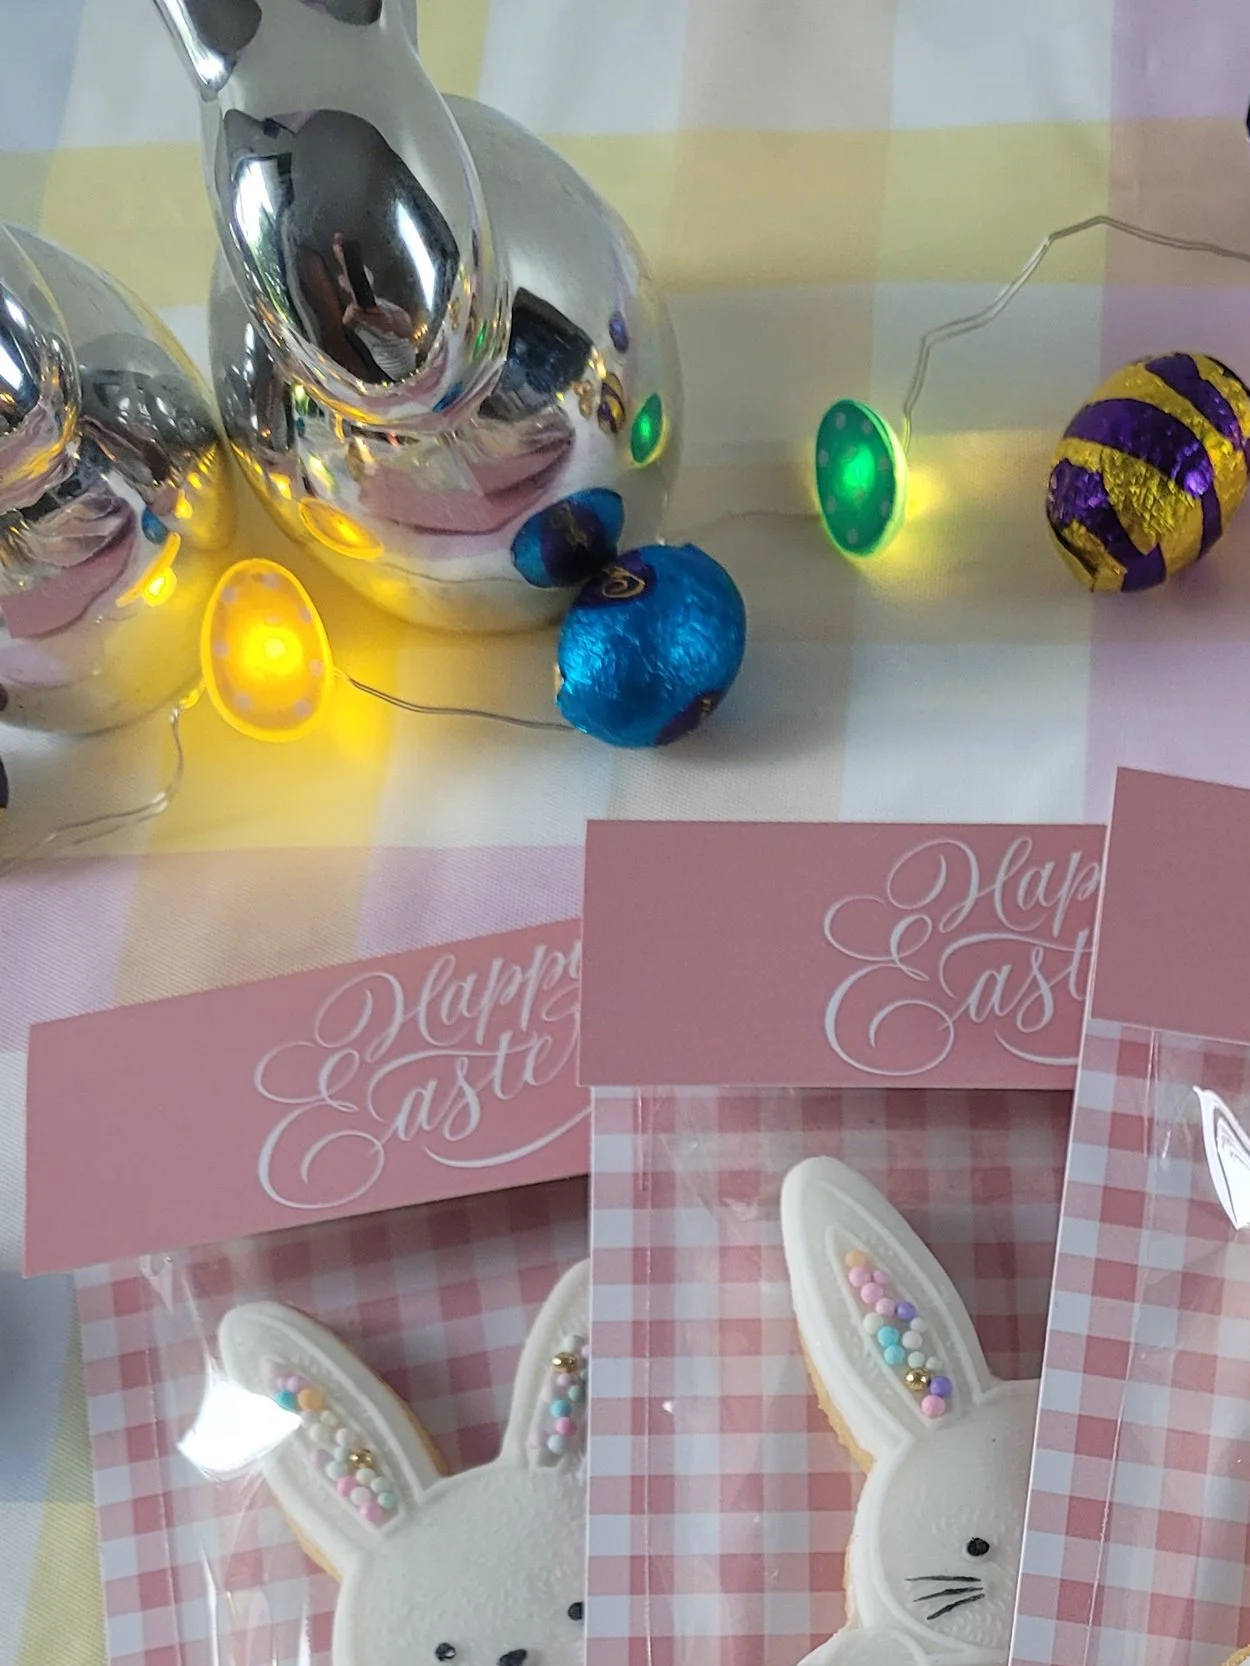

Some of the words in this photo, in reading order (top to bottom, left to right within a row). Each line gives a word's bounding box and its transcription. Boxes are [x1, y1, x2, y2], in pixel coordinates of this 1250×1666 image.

[887, 837, 1101, 937] Hap
[823, 895, 1097, 1077] East
[255, 1005, 592, 1209] Easte
